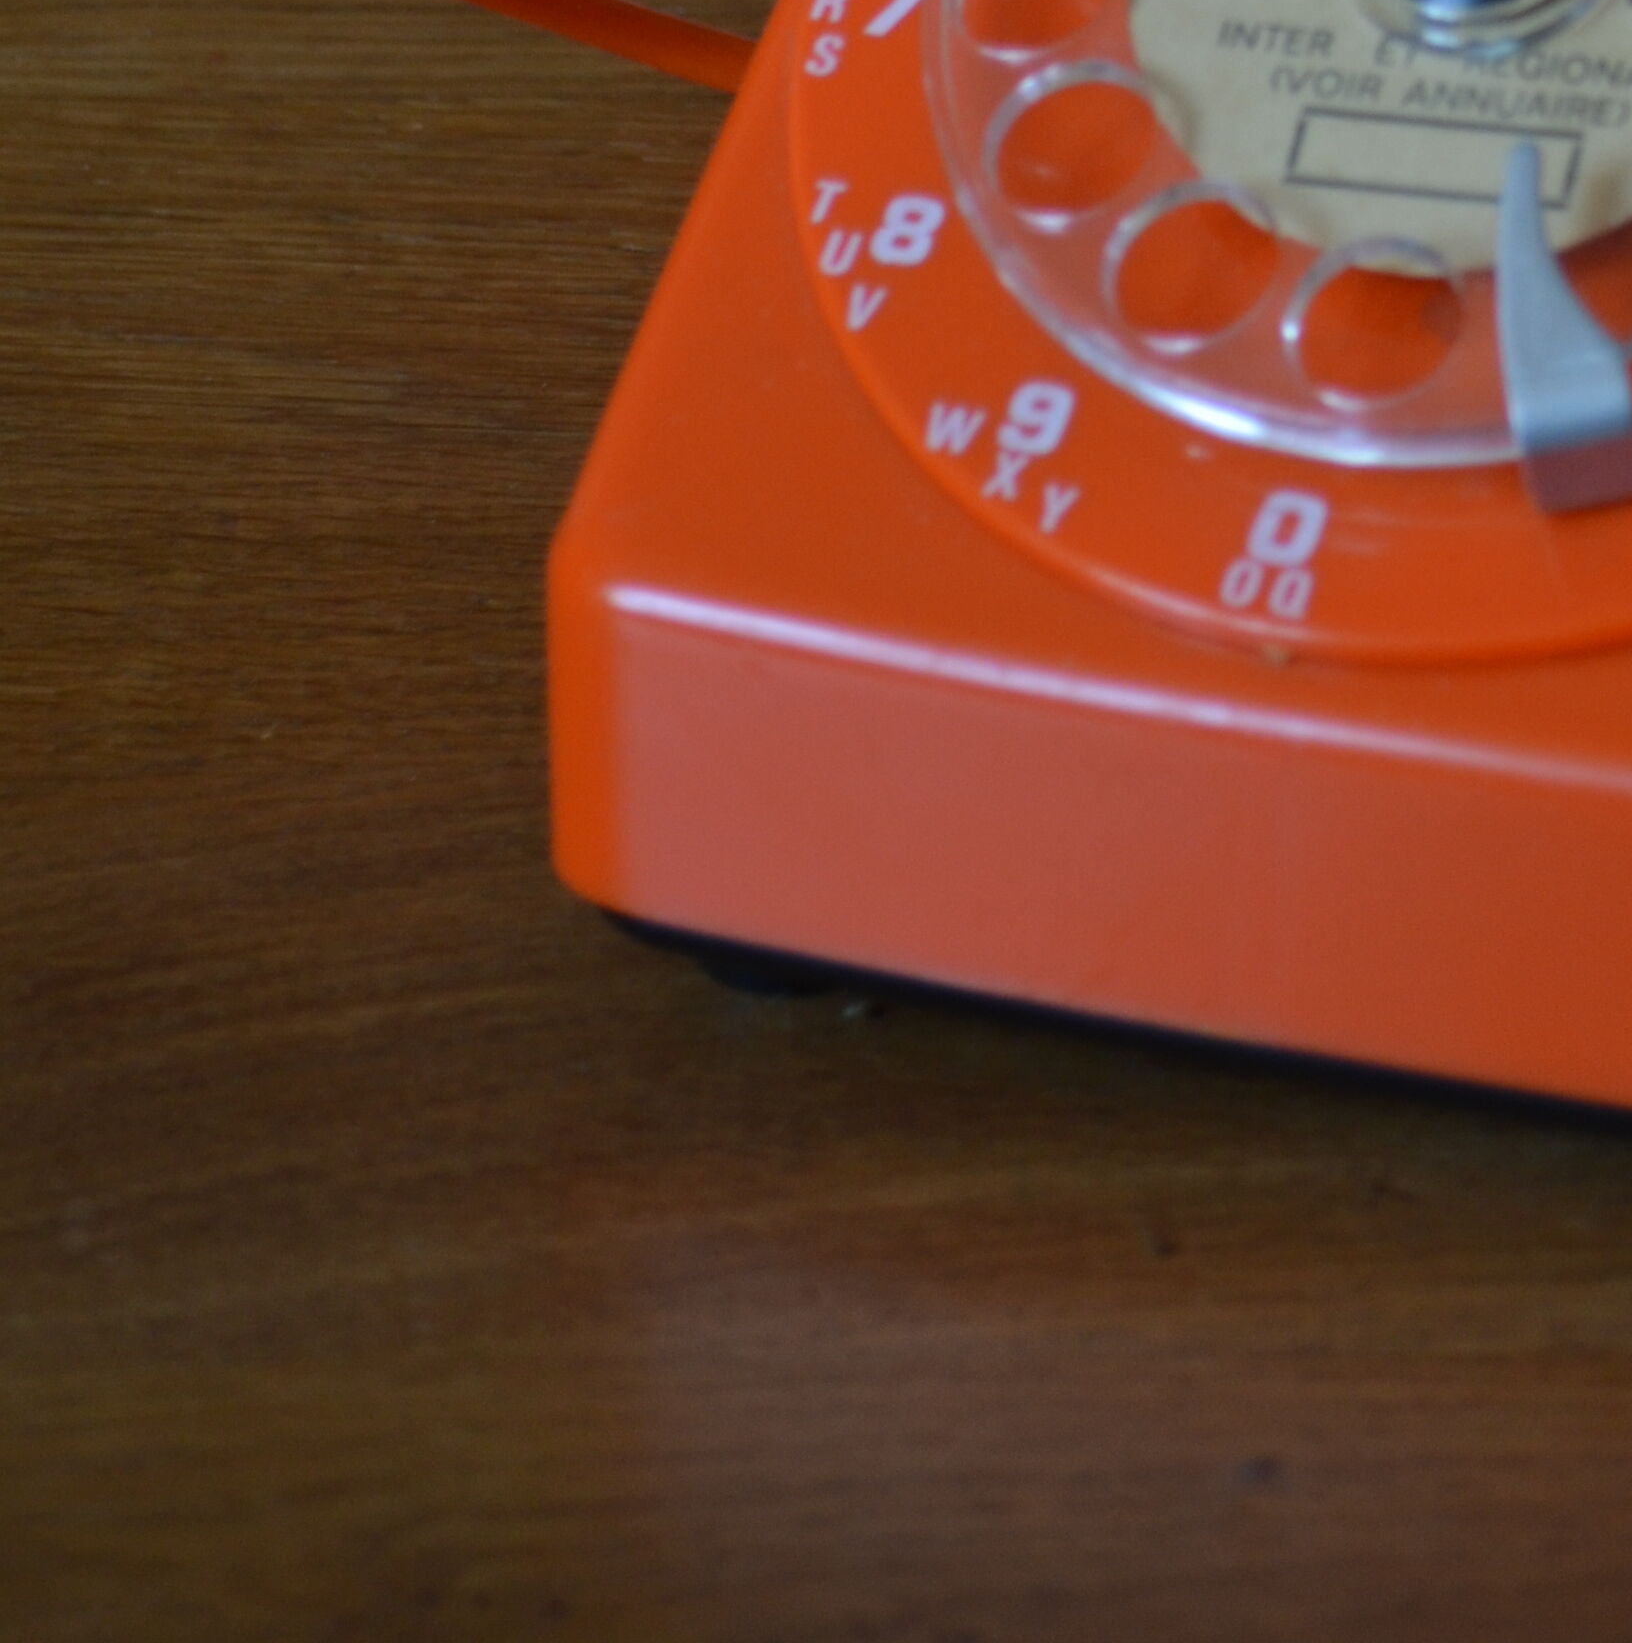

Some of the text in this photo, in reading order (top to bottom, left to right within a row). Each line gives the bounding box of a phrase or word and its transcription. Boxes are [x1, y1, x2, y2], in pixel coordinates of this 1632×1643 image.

[1215, 19, 1335, 59] INTER
[1267, 63, 1384, 102] (VOIR
[868, 194, 946, 267] 8
[999, 379, 1076, 456] 9
